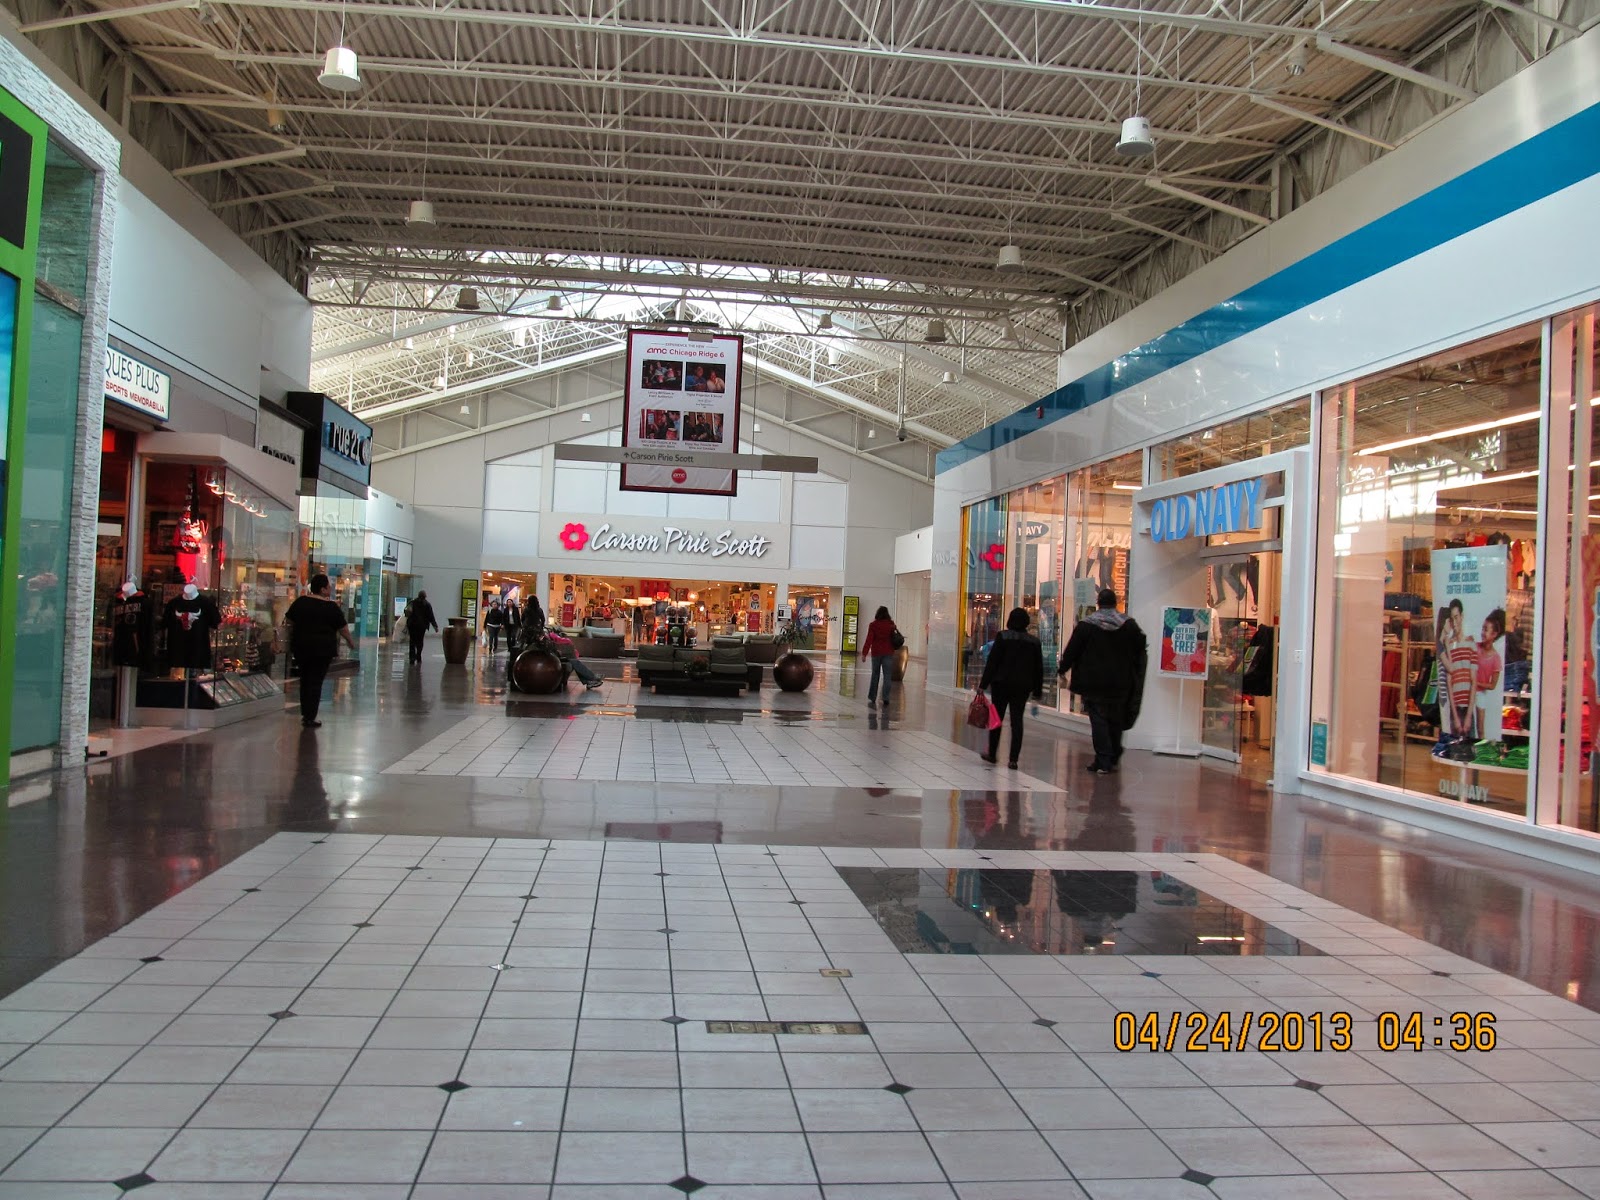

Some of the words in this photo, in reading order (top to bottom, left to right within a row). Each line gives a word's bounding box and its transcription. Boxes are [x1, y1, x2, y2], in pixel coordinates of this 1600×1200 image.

[136, 364, 160, 394] PLUS
[106, 380, 128, 398] SPORTS
[130, 391, 164, 413] MEMORABILIA
[630, 452, 656, 460] Carson
[658, 452, 674, 462] Pirie
[674, 454, 694, 463] Scott
[1151, 495, 1192, 543] OLD
[1194, 478, 1263, 537] NAVY
[591, 523, 660, 551] Carson
[663, 526, 711, 553] Pirie
[712, 529, 773, 558] Scott
[1114, 550, 1126, 597] BOOT-CUT
[1462, 572, 1479, 582] COLORS
[848, 616, 858, 644] FAMILY
[1174, 640, 1196, 652] FREE
[1438, 778, 1458, 796] OLD
